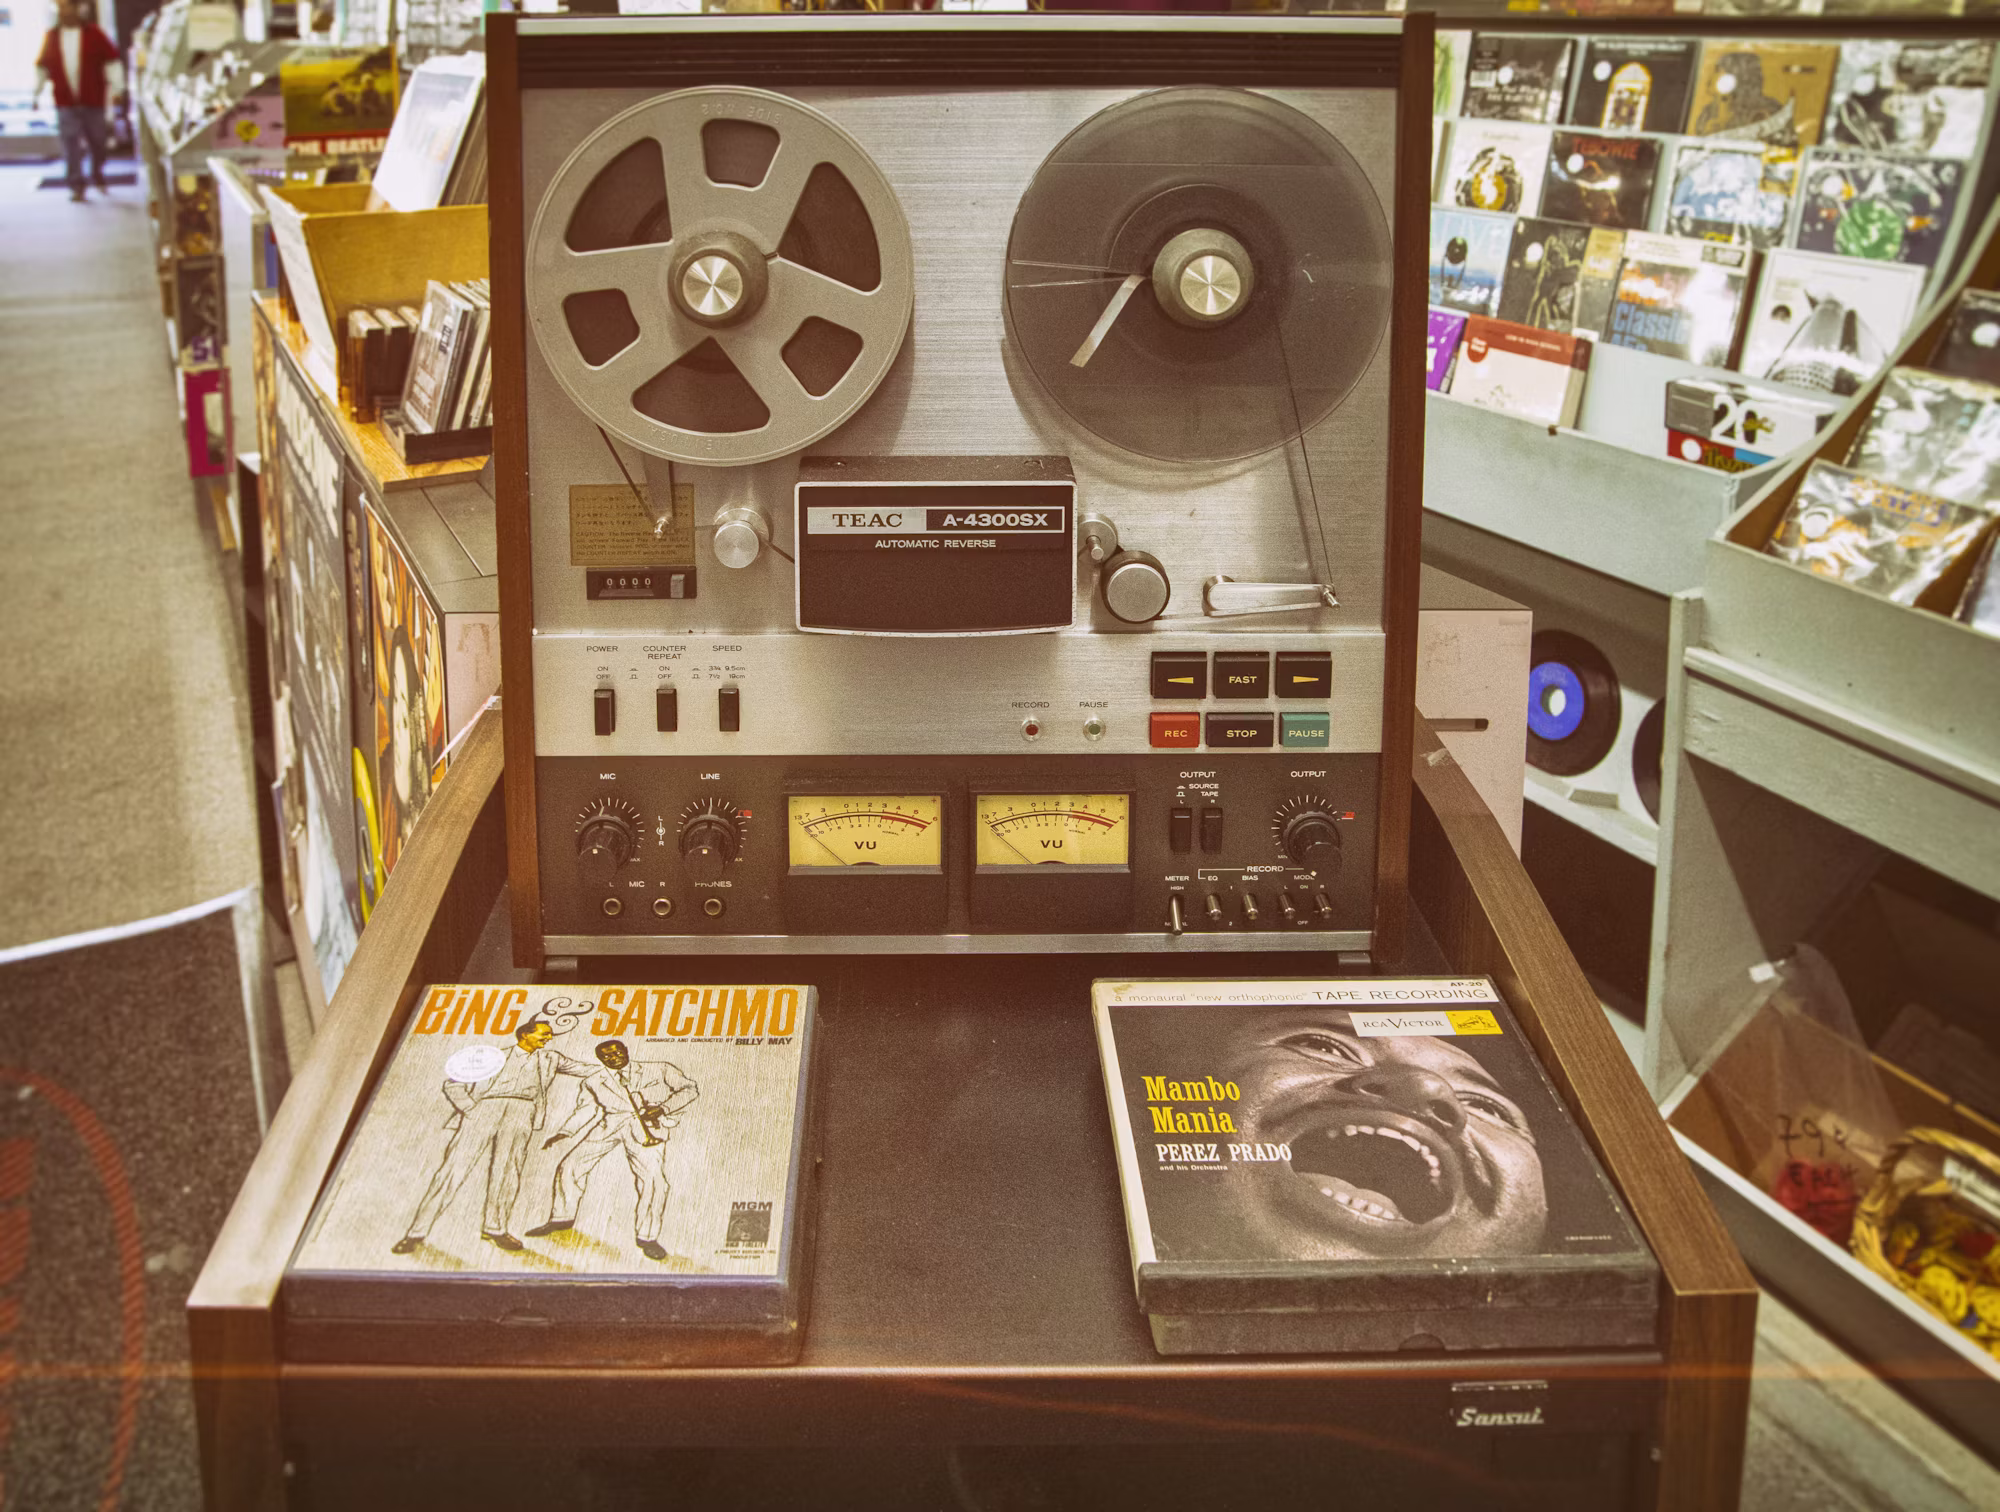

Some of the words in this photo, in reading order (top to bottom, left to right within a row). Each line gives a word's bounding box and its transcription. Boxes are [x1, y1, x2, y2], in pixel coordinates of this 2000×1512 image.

[327, 137, 387, 154] BEATLE
[832, 514, 902, 528] TEAC
[943, 513, 1048, 526] A-4300SX
[875, 540, 939, 548] AUTOMATIC
[944, 540, 996, 548] REVERSE
[854, 841, 877, 850] VU
[1040, 840, 1063, 848] VU
[1129, 994, 1186, 1002] monaural
[1313, 991, 1362, 1000] TAPE
[1370, 990, 1488, 1000] RECORDING
[590, 988, 799, 1036] SATCHMO
[1141, 1076, 1240, 1102] Mambo
[1148, 1106, 1238, 1133] Mania
[1155, 1144, 1220, 1162] PEREZ
[1227, 1143, 1292, 1162] PRADO
[732, 1202, 772, 1210] MGM
[1456, 1406, 1544, 1426] Sansui
